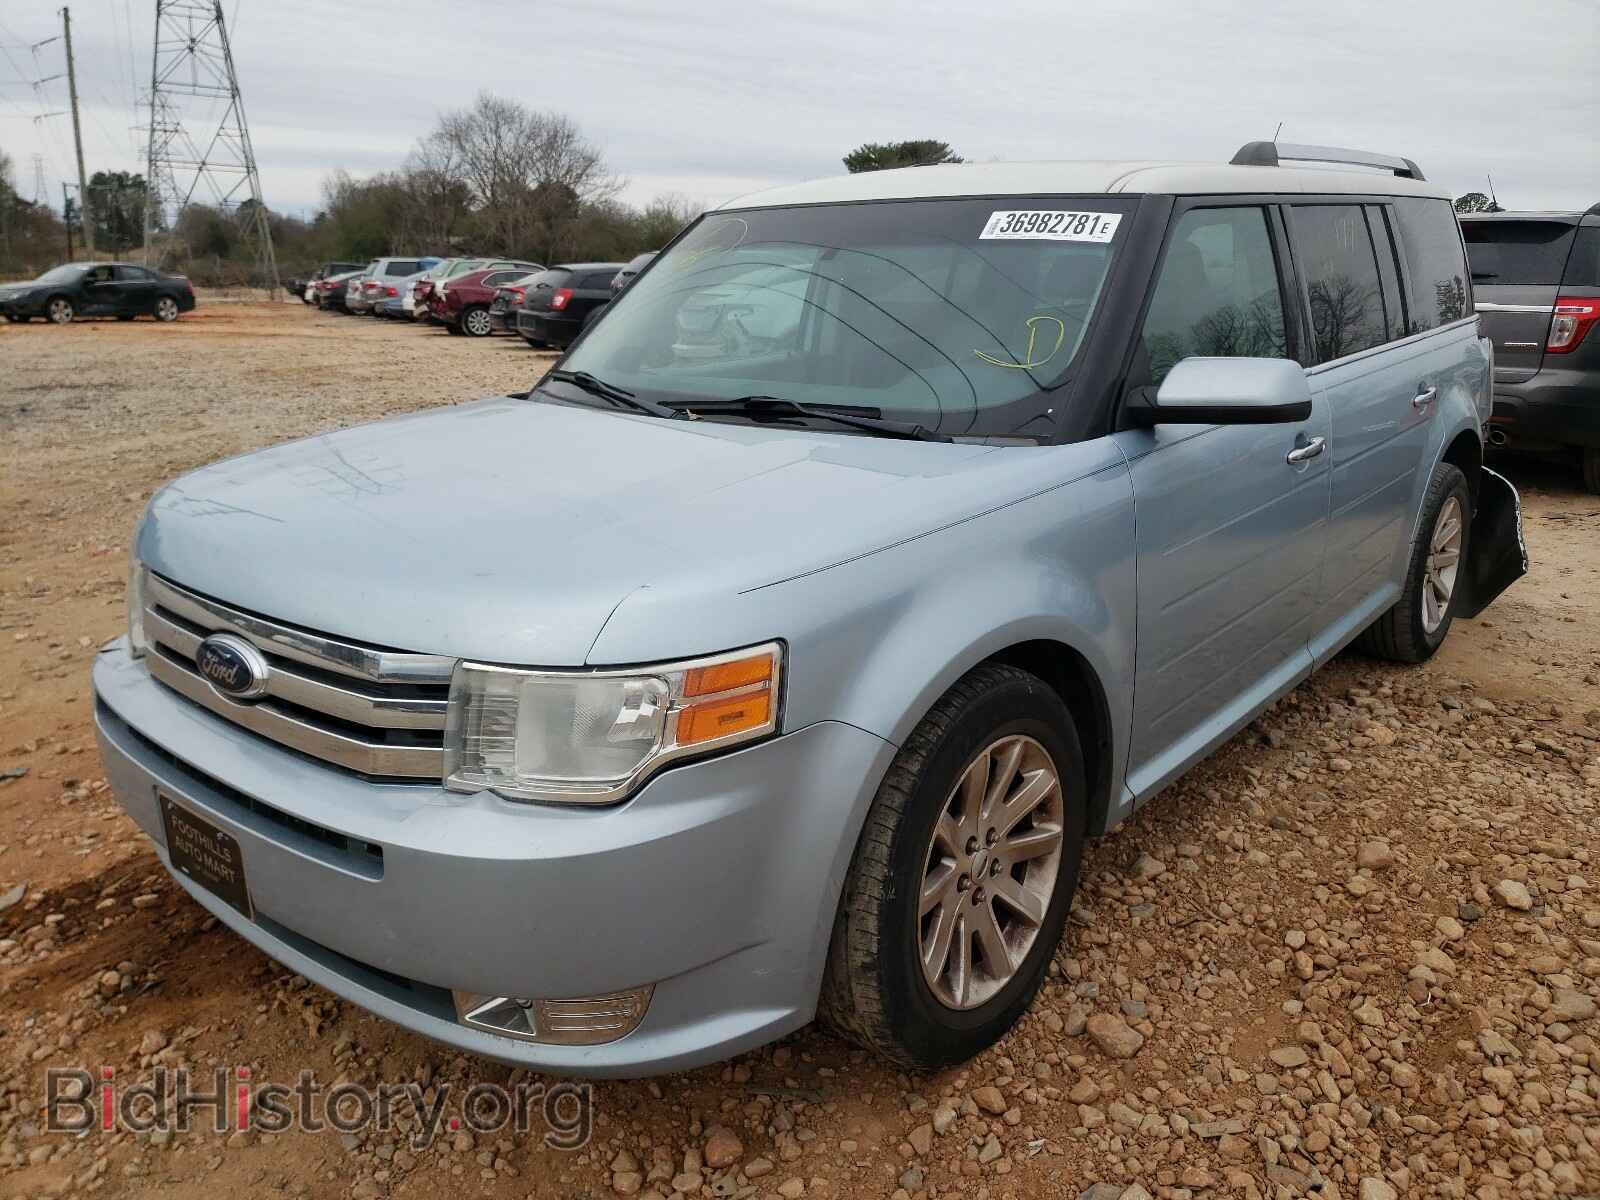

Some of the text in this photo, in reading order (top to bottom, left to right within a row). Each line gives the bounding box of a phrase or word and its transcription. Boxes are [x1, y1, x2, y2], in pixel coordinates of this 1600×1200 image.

[1000, 213, 1102, 235] 36982781
[1101, 222, 1110, 234] E
[203, 650, 239, 685] Ford
[171, 814, 232, 863] FOOTHILLS
[175, 835, 202, 862] AUTO
[203, 853, 235, 884] MART
